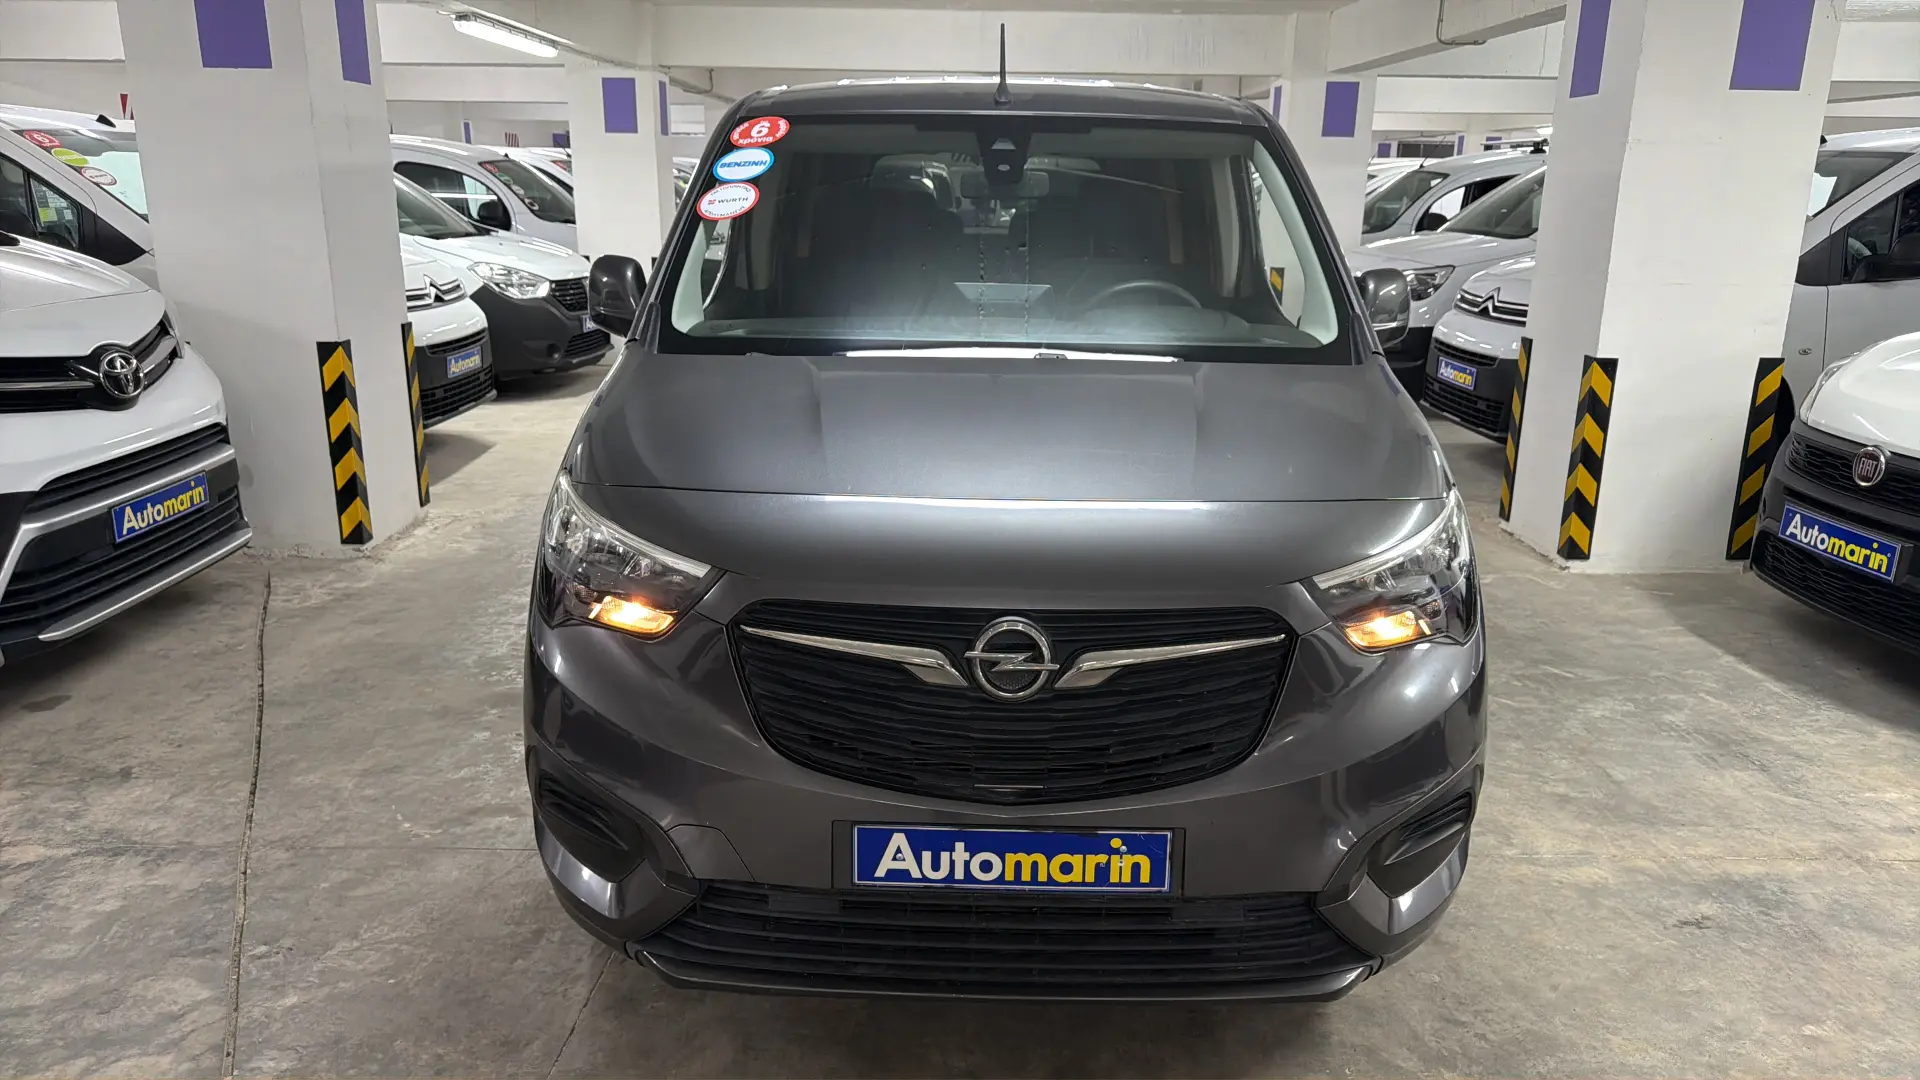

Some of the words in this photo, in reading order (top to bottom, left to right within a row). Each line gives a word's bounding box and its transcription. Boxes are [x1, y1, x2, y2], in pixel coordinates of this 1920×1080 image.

[750, 121, 771, 137] 6
[450, 351, 480, 374] Automarin
[1440, 360, 1472, 386] Automarin
[1858, 457, 1879, 478] FIAT
[123, 480, 205, 535] Automarin
[1785, 513, 1888, 573] Automarin
[873, 832, 1151, 884] Automarin
